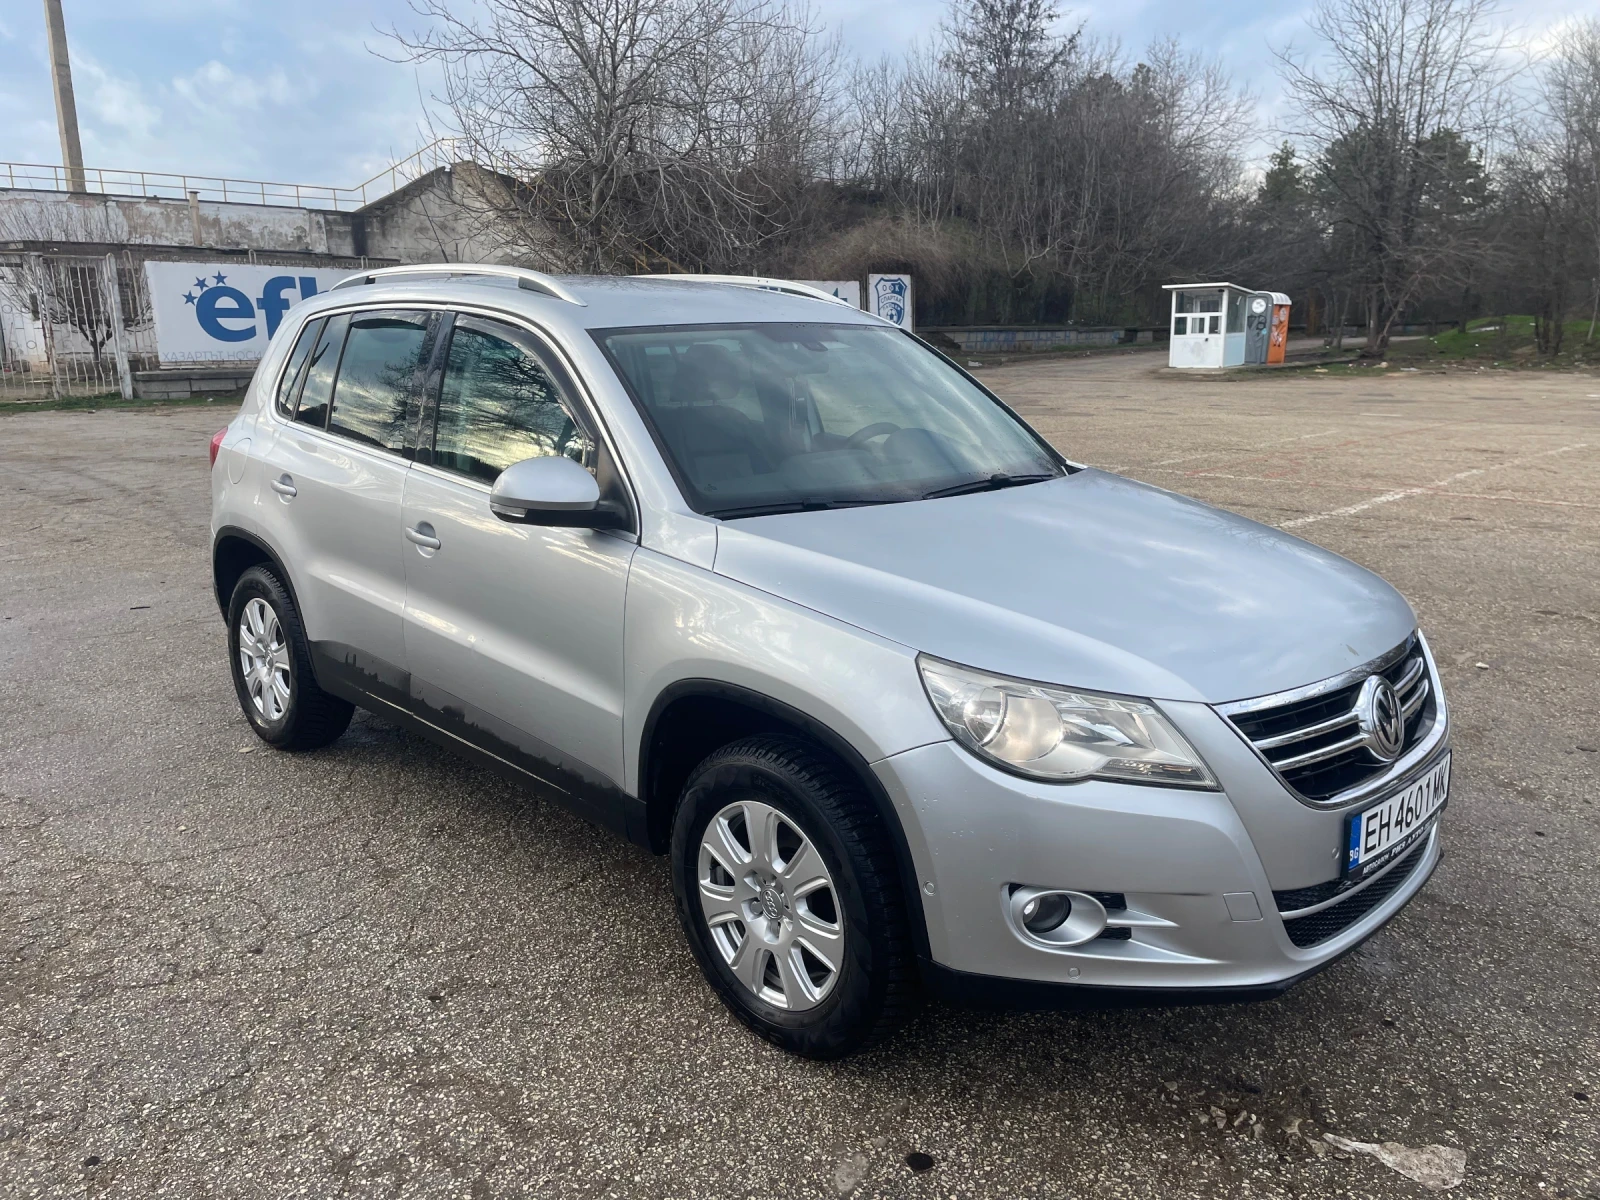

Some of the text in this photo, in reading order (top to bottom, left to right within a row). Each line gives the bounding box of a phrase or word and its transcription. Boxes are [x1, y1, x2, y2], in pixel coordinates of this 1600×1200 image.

[880, 295, 902, 303] СПАРТАК
[162, 351, 223, 362] ХАЗАРТЪТ
[1349, 846, 1359, 862] BG
